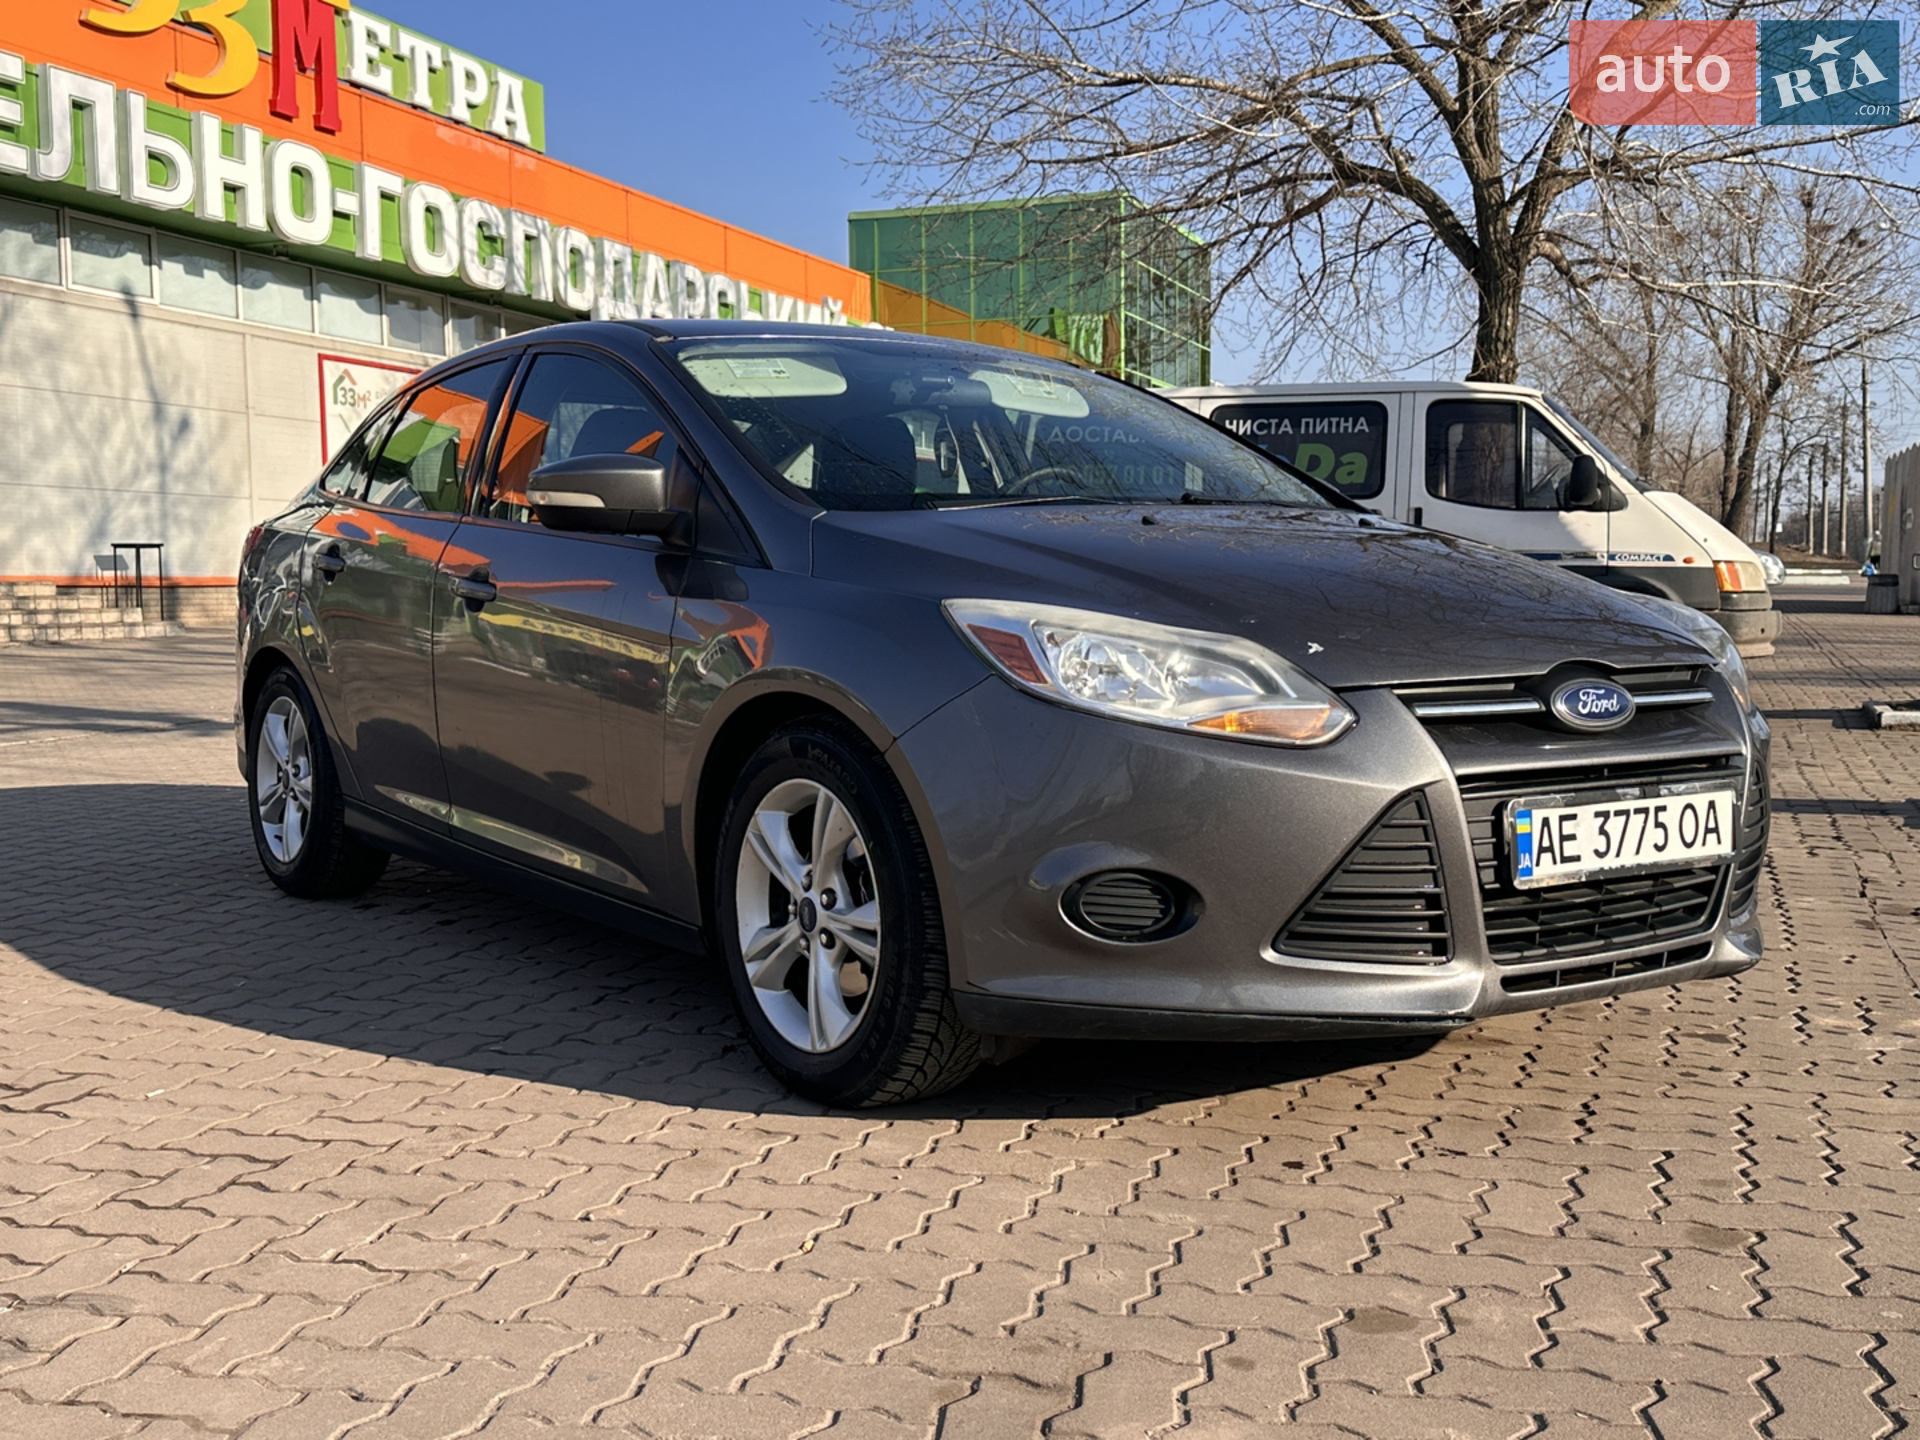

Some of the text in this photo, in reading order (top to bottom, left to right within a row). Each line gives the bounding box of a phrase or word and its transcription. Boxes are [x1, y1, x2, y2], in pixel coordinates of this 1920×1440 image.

[79, 0, 259, 96] 3
[1225, 416, 1370, 436] ЧИСТА ПИТНА
[1615, 553, 1665, 562] COMPACT
[1577, 688, 1620, 715] Ford
[1535, 799, 1722, 868] AE 3775 OA
